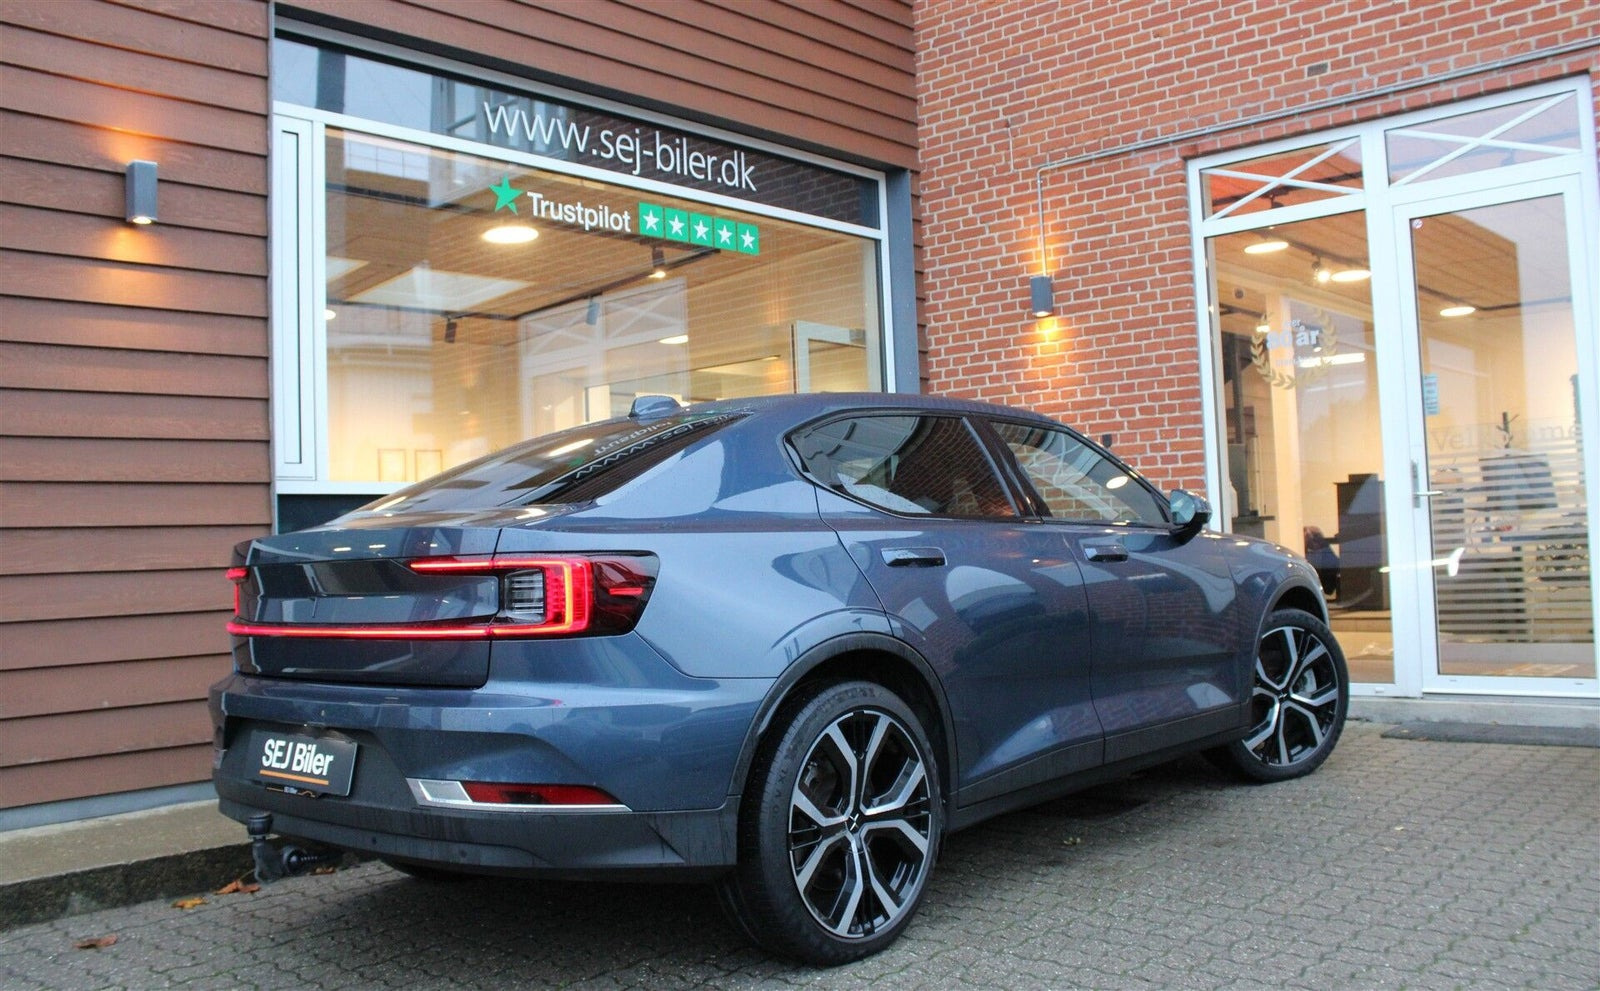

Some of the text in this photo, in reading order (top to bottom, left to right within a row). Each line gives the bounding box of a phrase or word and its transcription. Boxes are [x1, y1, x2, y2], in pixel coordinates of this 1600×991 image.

[483, 101, 757, 191] www.sej-biler.dk
[527, 191, 631, 233] Trustpilot
[262, 739, 334, 776] SEJ Biler
